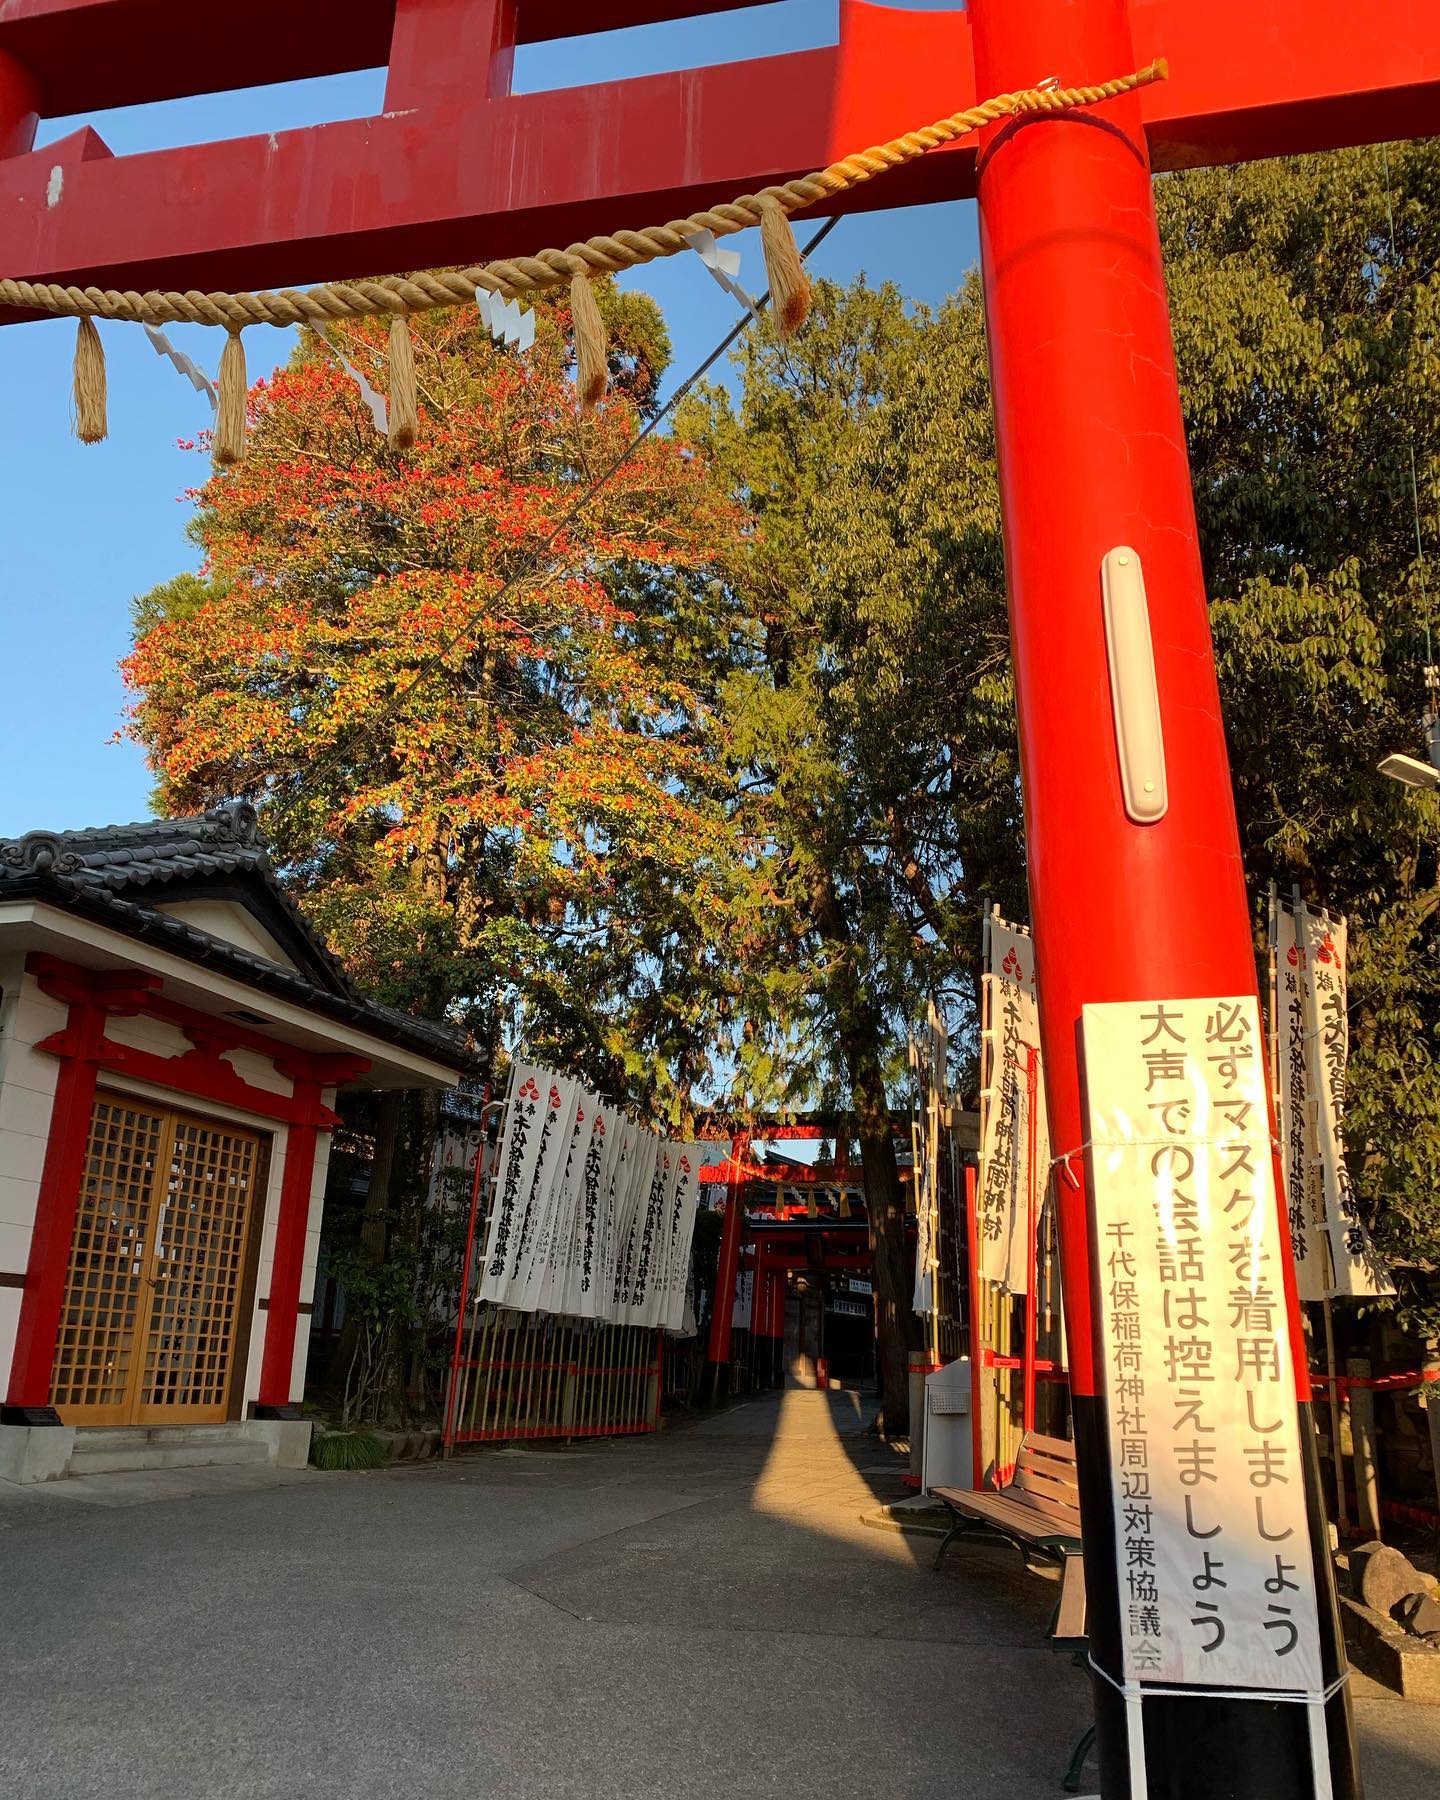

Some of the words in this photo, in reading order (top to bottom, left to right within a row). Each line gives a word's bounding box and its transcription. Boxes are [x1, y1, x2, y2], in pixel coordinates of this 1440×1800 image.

[1105, 1221, 1163, 1674] 千代保稲荷神社周辺対策協議会
[1140, 1004, 1227, 1655] 大声での会話は控えましょう
[1205, 1002, 1301, 1657] 必ずマスクを着用しましょう
